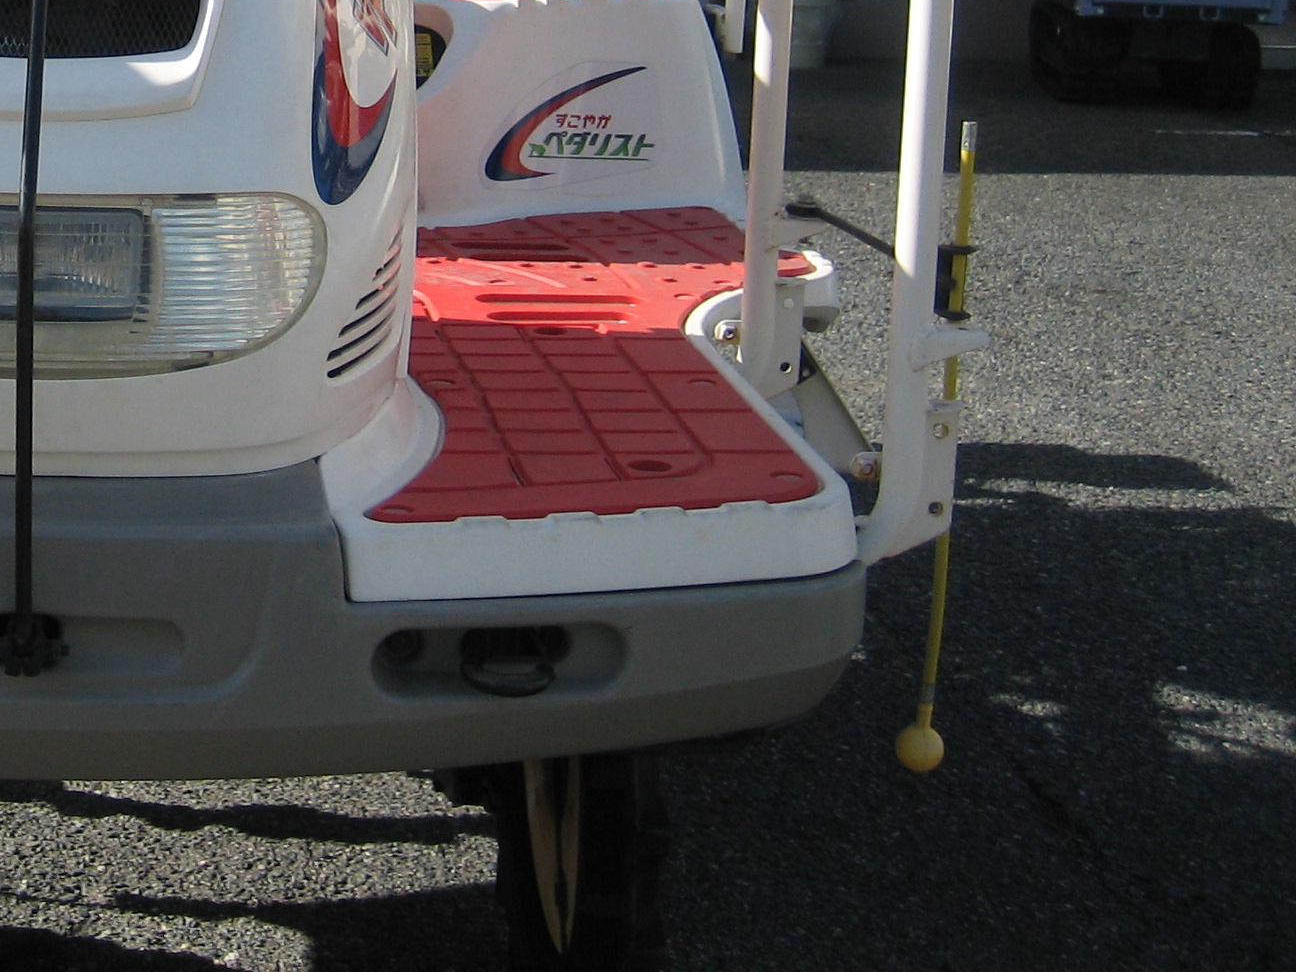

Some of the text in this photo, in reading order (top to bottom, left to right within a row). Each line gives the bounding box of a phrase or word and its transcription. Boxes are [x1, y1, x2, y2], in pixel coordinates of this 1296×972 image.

[556, 114, 611, 129] すこやか
[544, 132, 655, 156] ペダリスト
